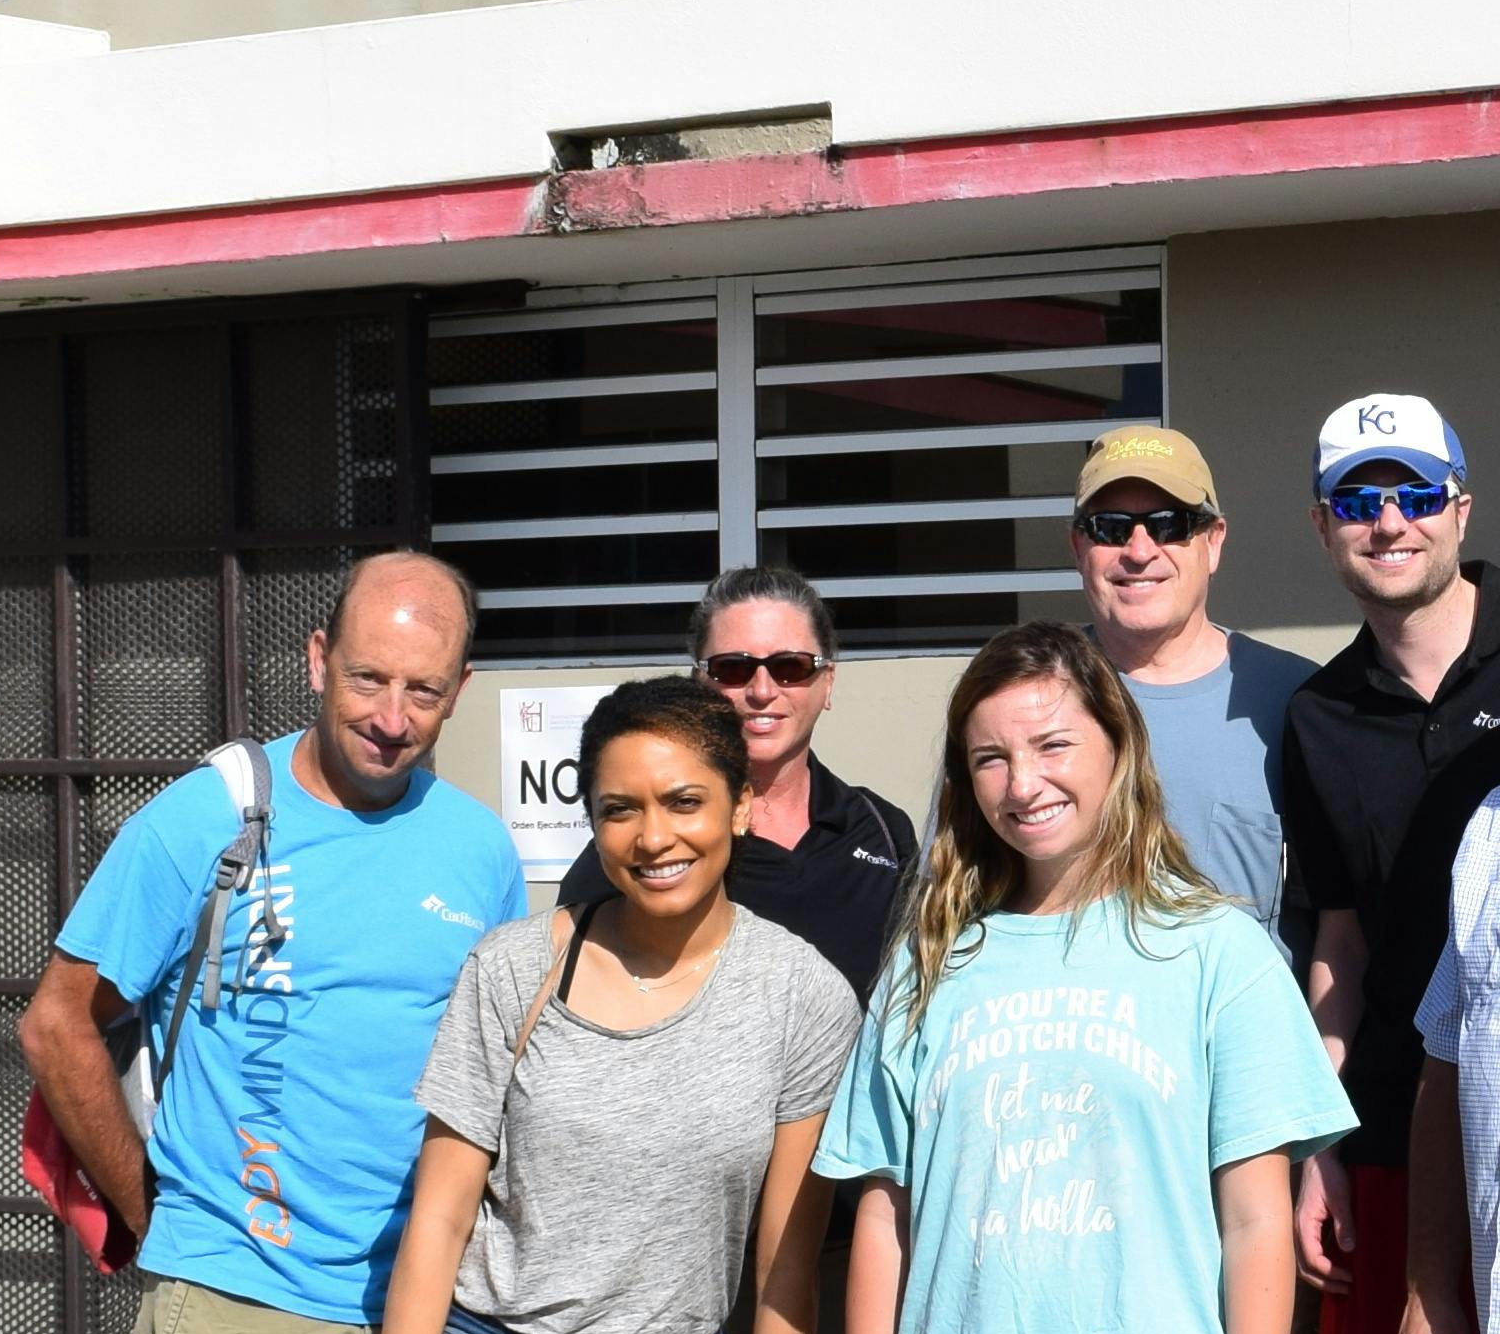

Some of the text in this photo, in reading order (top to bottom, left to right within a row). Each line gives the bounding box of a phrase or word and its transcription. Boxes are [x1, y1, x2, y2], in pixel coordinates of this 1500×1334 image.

[1358, 404, 1397, 435] KC
[950, 986, 1136, 1050] IF YOU'RE A
[238, 993, 289, 1131] MIND
[965, 1021, 1078, 1073] NOTCH
[1083, 1024, 1178, 1104] CHIEF
[983, 1062, 1097, 1129] let me
[1020, 1168, 1116, 1238] holla
